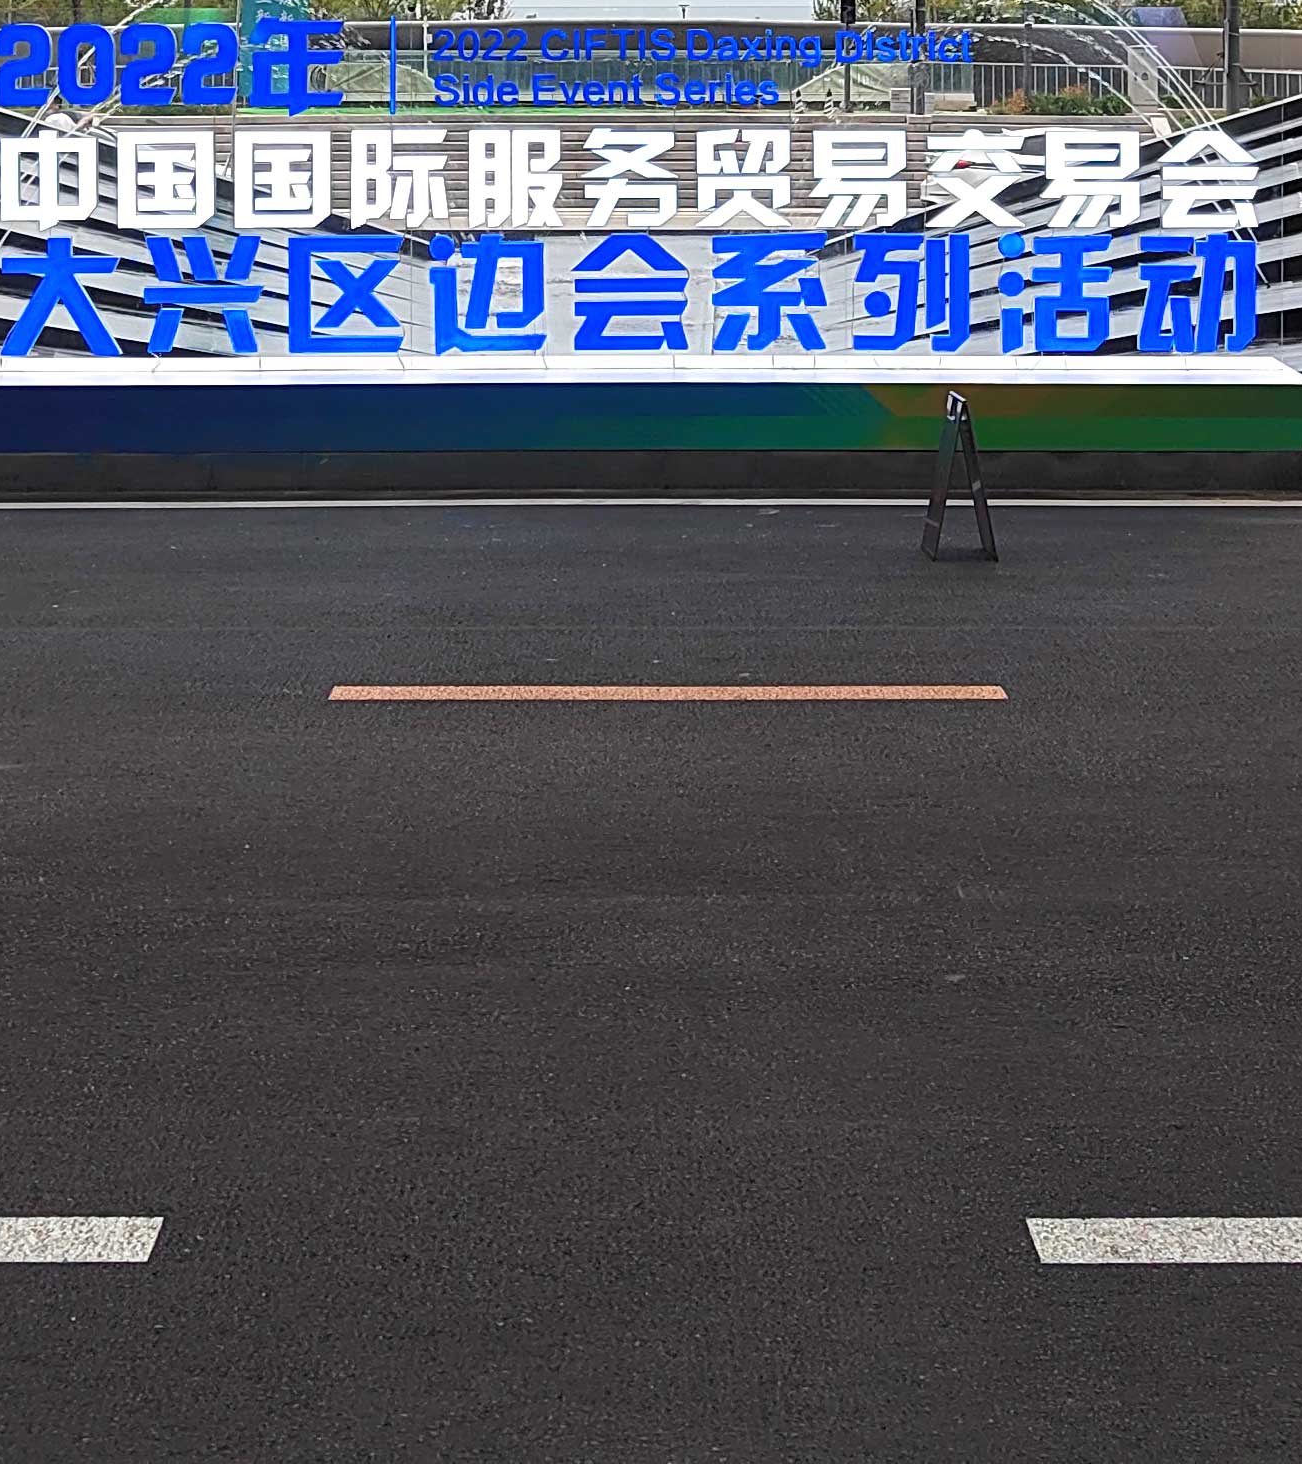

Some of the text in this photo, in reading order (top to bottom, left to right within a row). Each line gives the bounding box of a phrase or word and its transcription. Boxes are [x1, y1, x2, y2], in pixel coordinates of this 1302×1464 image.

[432, 28, 973, 68] 2022 CIFTIS Daxing District
[434, 73, 779, 106] Side Event Series
[0, 128, 1259, 231] 中国国际服务贸易交易会
[0, 233, 1258, 353] 大兴区边会系列活动
